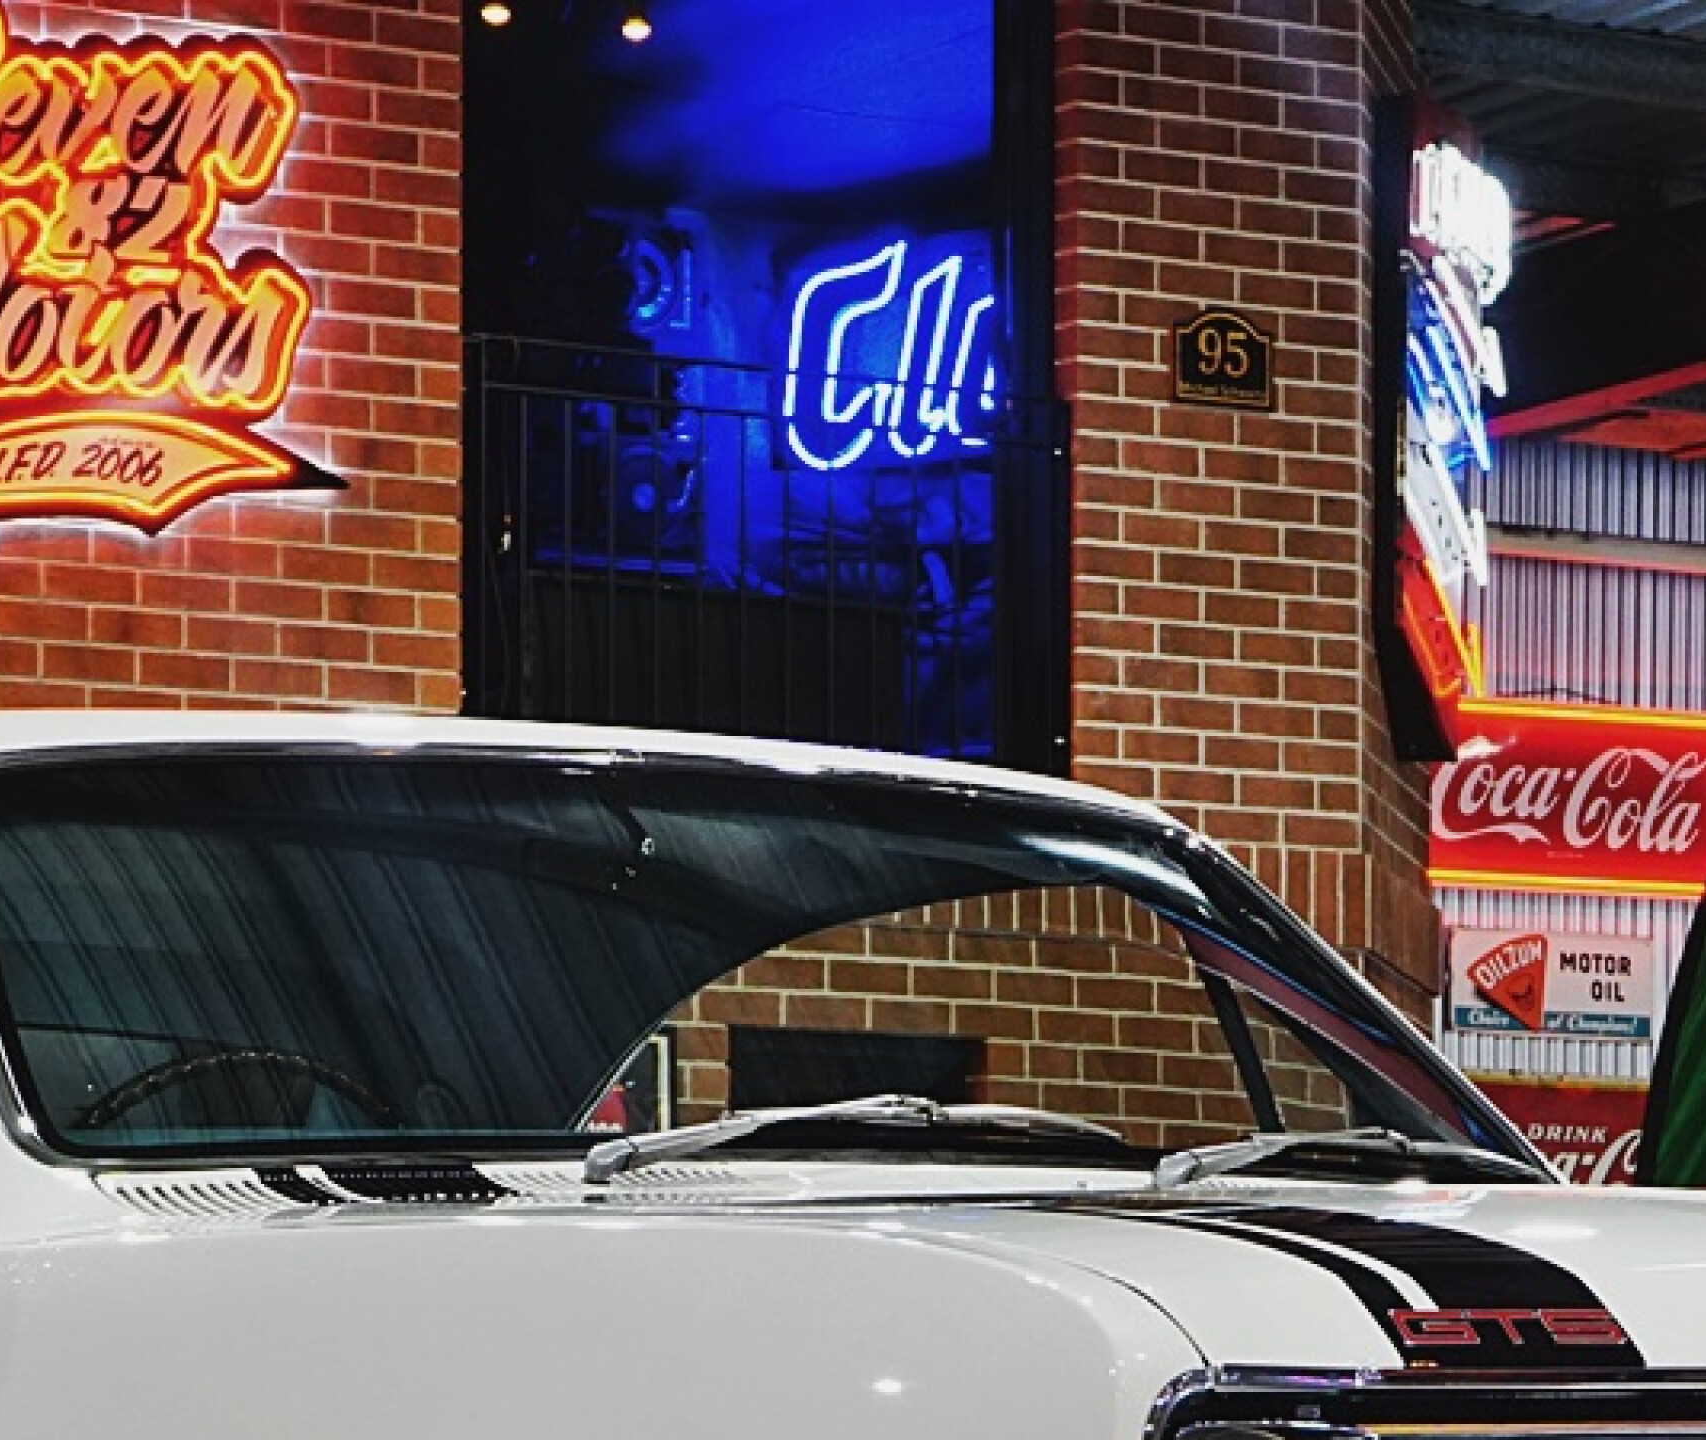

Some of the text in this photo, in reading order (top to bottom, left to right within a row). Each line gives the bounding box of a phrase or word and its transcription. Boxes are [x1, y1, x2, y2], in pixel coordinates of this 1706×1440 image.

[51, 174, 191, 263] 82
[1197, 327, 1250, 377] 95
[71, 443, 165, 488] 2006
[1559, 951, 1632, 977] MOTOR
[1591, 980, 1626, 1002] OIL
[1527, 1122, 1610, 1144] DRINK
[1387, 1308, 1628, 1345] GTS
